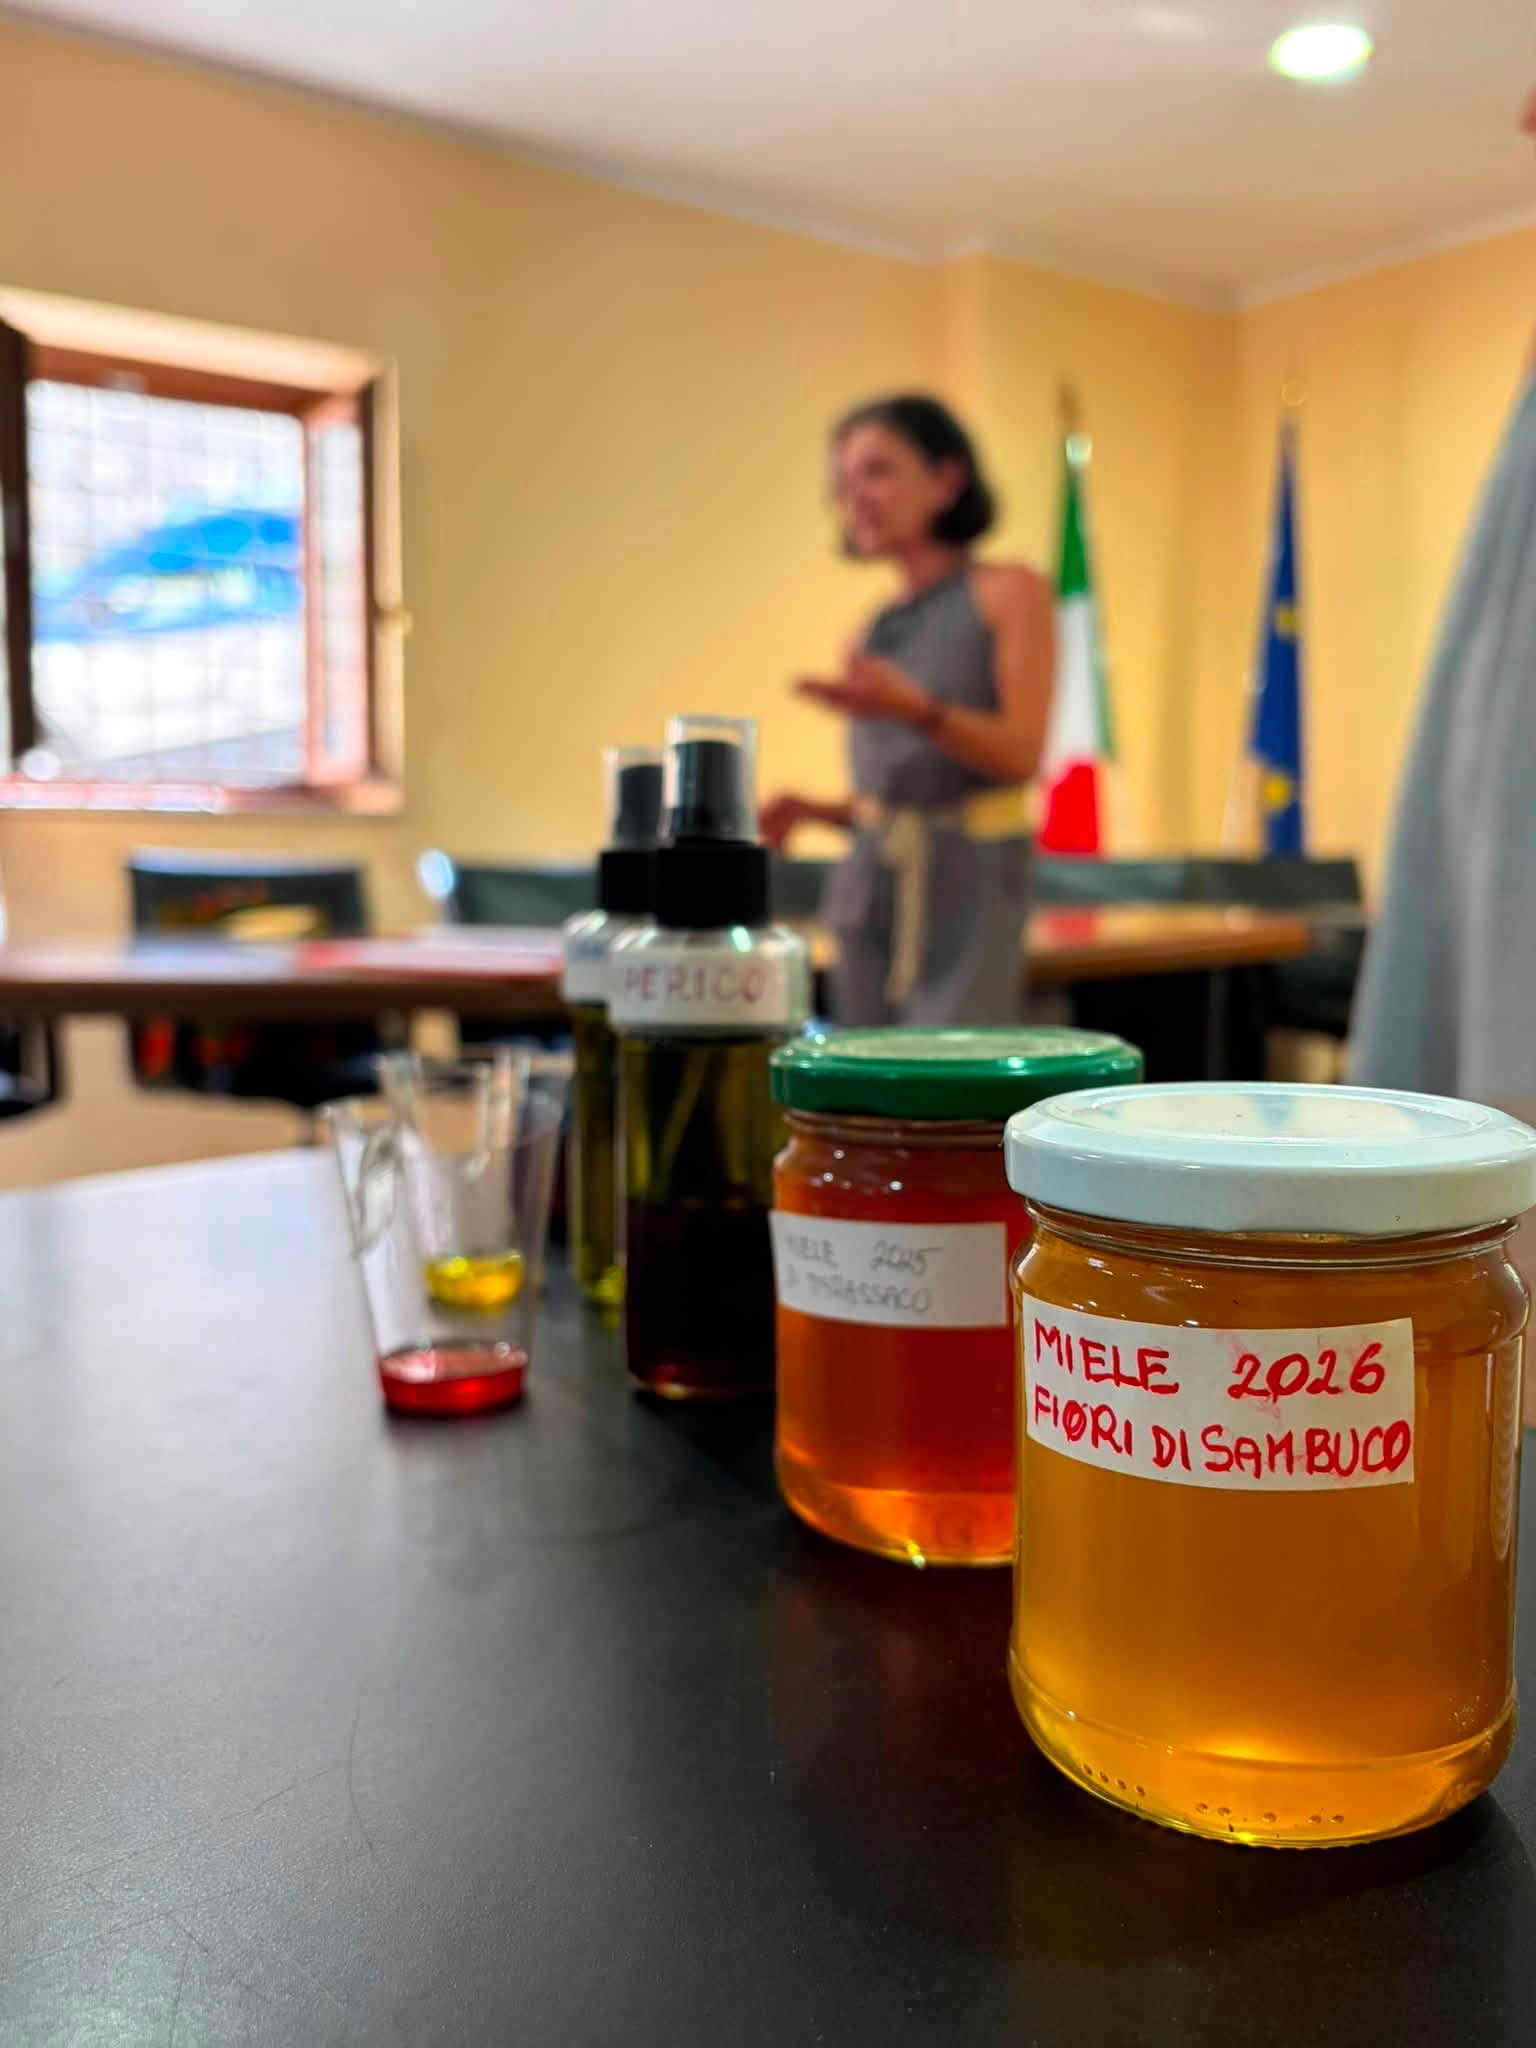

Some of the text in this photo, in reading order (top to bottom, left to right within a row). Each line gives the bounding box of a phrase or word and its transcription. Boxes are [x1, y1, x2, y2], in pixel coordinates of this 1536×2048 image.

[1033, 1317, 1387, 1404] MIELE 2026
[1034, 1383, 1412, 1480] FIORI DI SAMBUCO
